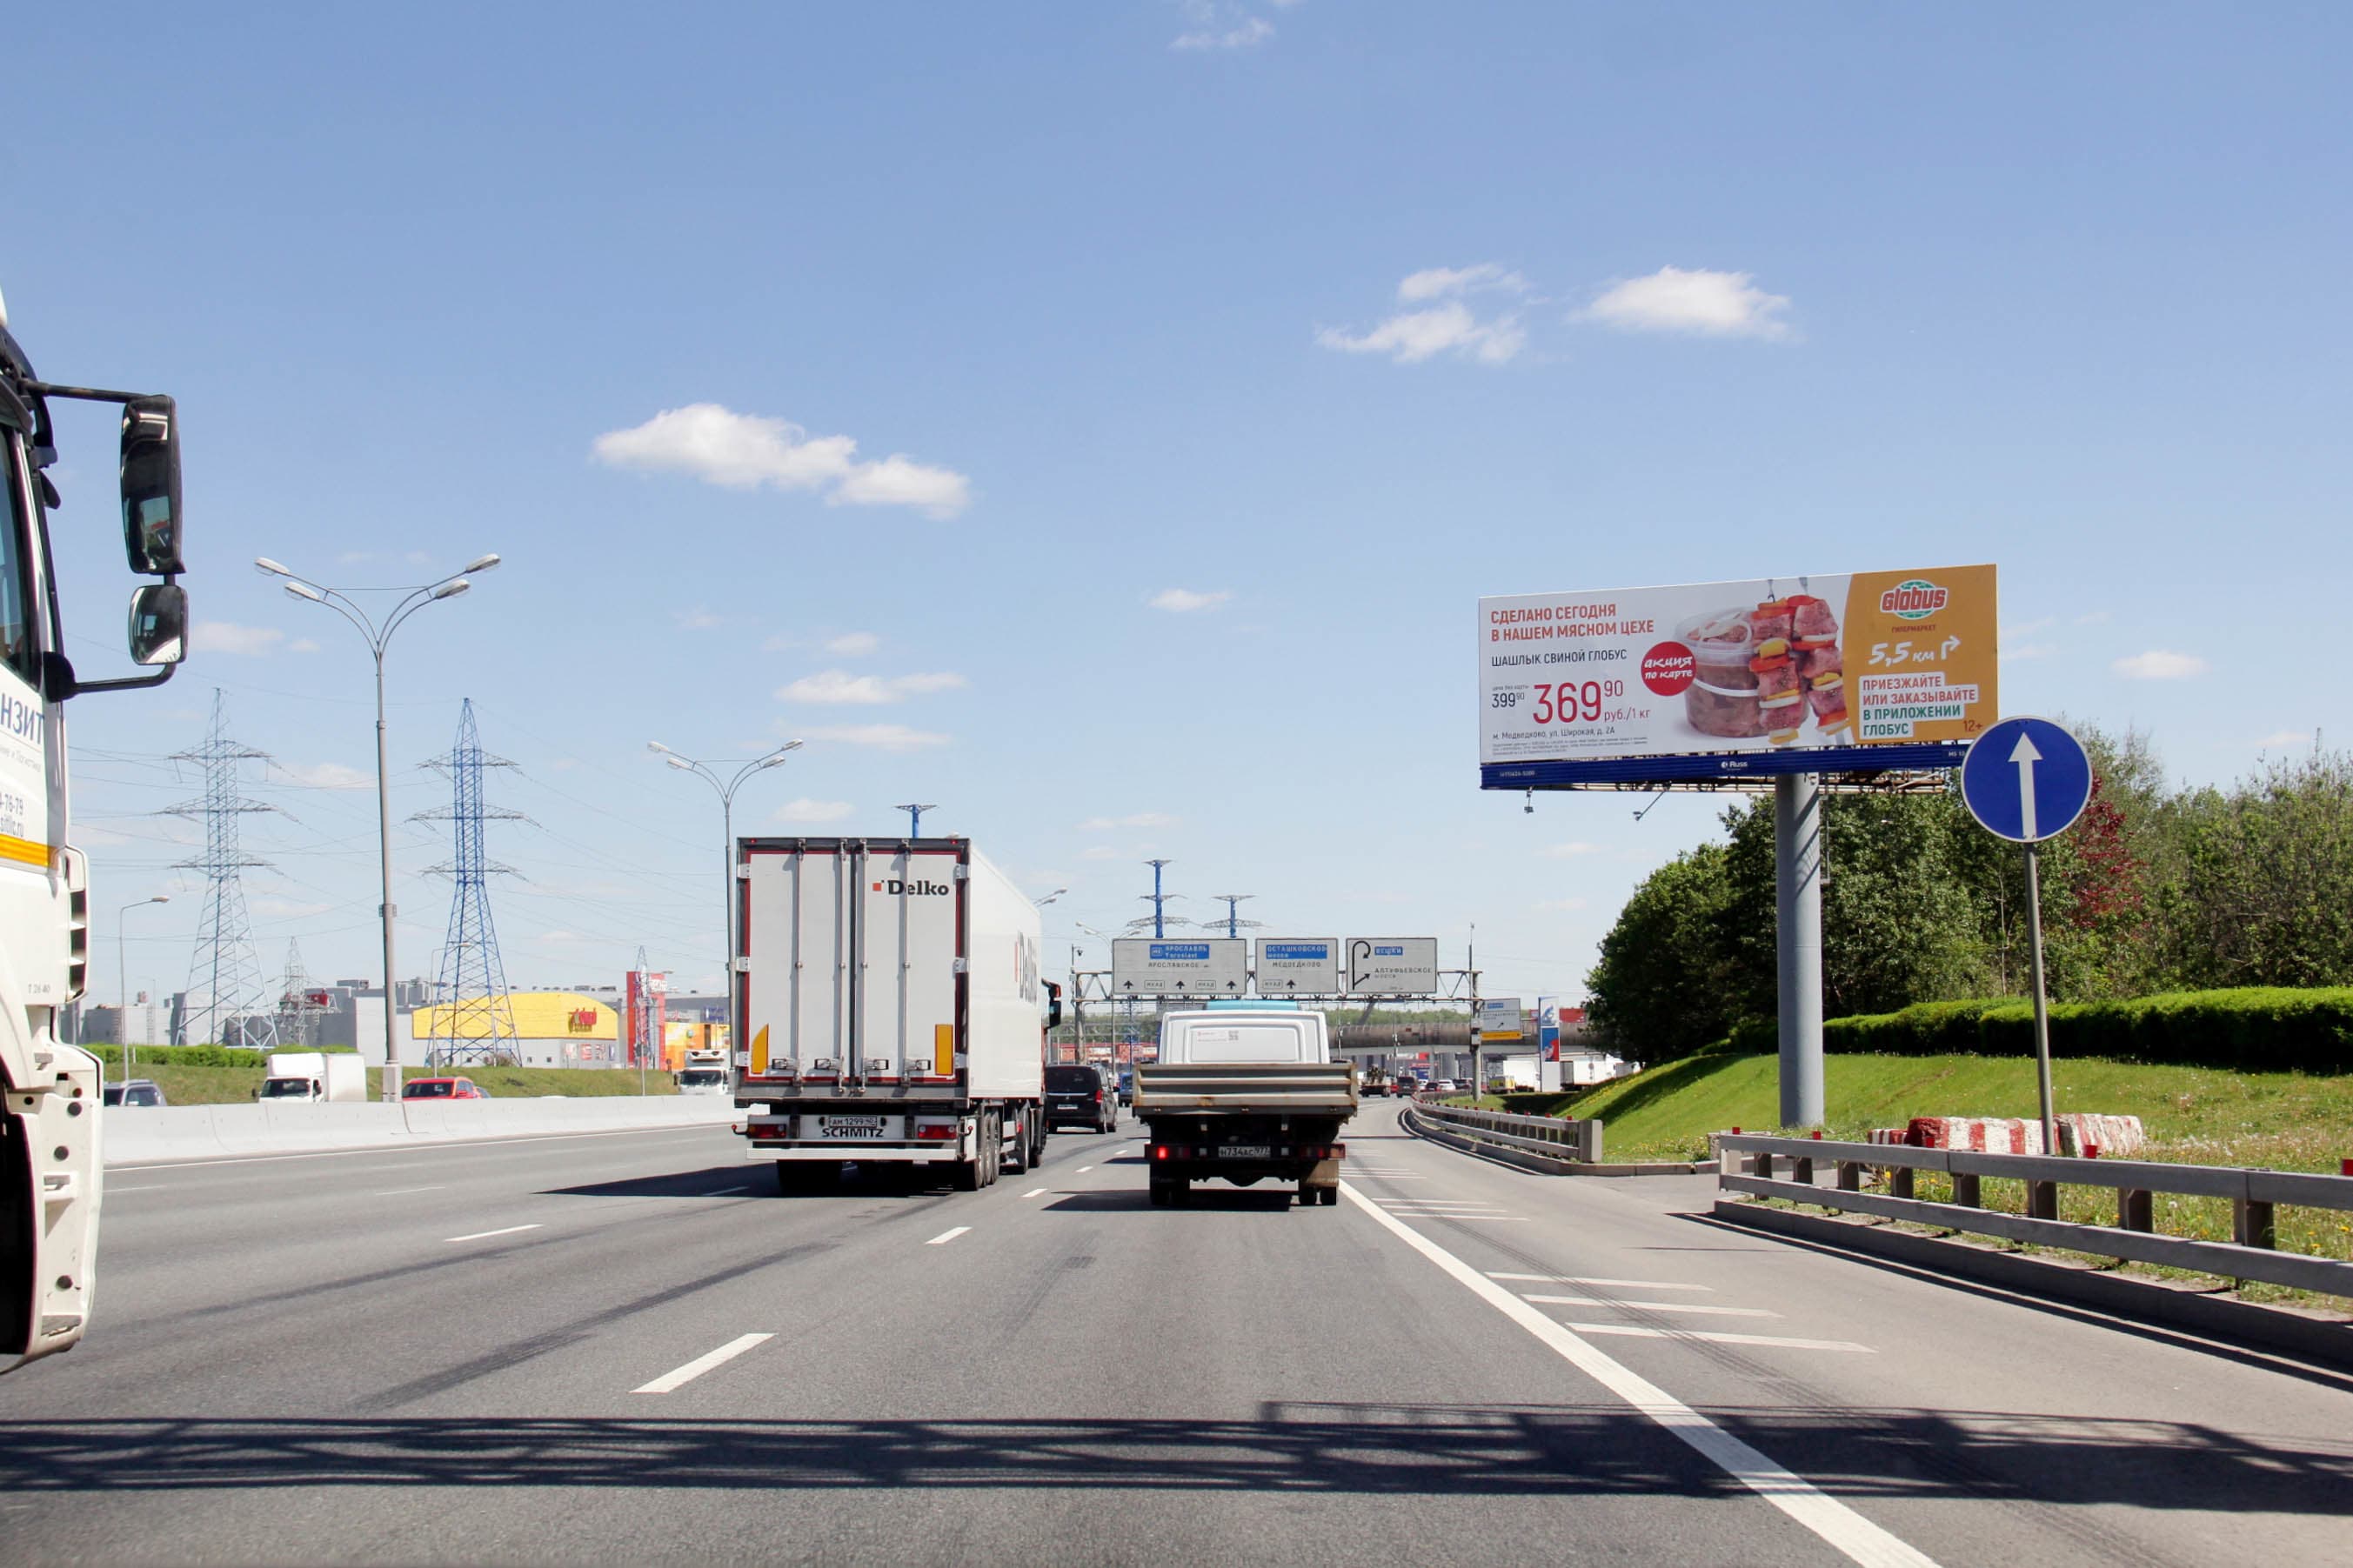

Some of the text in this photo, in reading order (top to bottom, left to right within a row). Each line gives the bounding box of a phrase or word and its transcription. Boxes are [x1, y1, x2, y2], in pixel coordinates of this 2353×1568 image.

[1882, 586, 1946, 611] Globus
[1491, 604, 1616, 625] СДЕЛАНО СЕГОДНЯ
[1491, 620, 1654, 642] В НАШЕМ МЯСНОМ ЦЕХЕ
[1492, 649, 1628, 667] ШАШЛЫК СВИНОЙ ГЛОБУС
[1644, 656, 1693, 668] акция
[1868, 641, 1935, 667] 5,5 км
[1645, 670, 1693, 680] по карте
[1862, 675, 1942, 691] ПРИЕЗЖАЙТЕ
[1492, 692, 1515, 708] 399
[1533, 680, 1623, 724] 369 90
[1862, 687, 1975, 706] ИЛИ ЗАКАЗЫВАЙТЕ
[1640, 709, 1651, 719] кг
[1863, 704, 1961, 720] В ПРИЛОЖЕНИИ
[1863, 724, 1909, 736] ГЛОБУС
[1963, 720, 1983, 732] 12+
[887, 879, 949, 896] Delko
[821, 1128, 884, 1138] SCHMITZ
